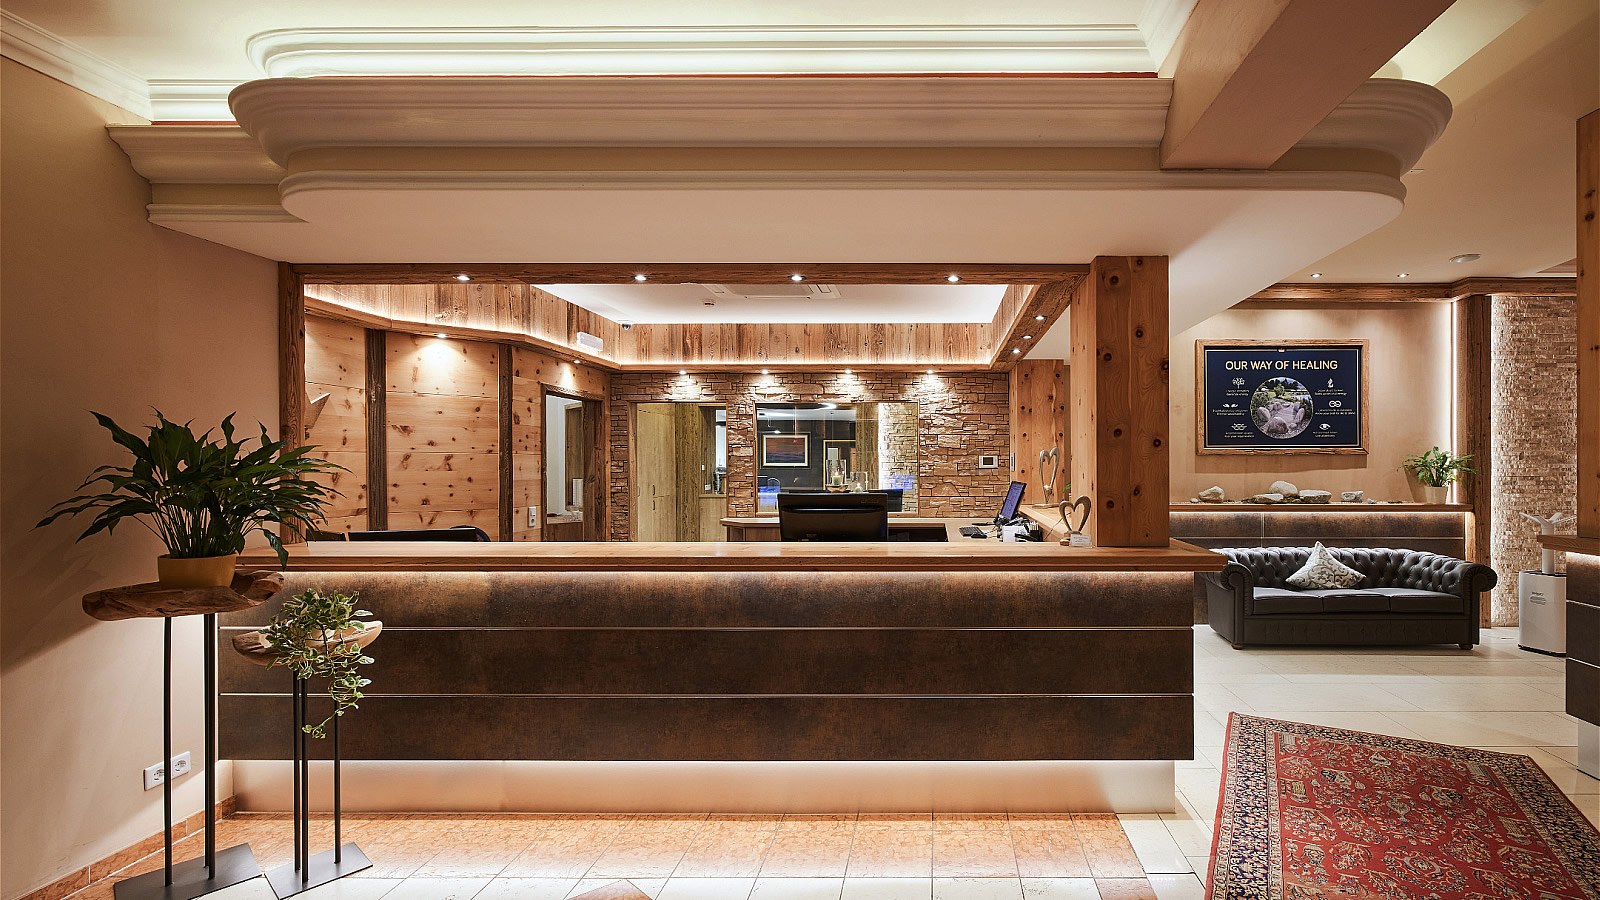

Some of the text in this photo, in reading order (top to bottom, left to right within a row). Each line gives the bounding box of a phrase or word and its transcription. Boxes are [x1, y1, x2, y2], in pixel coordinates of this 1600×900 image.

[1225, 360, 1338, 370] OUR WAY OF HEALING
